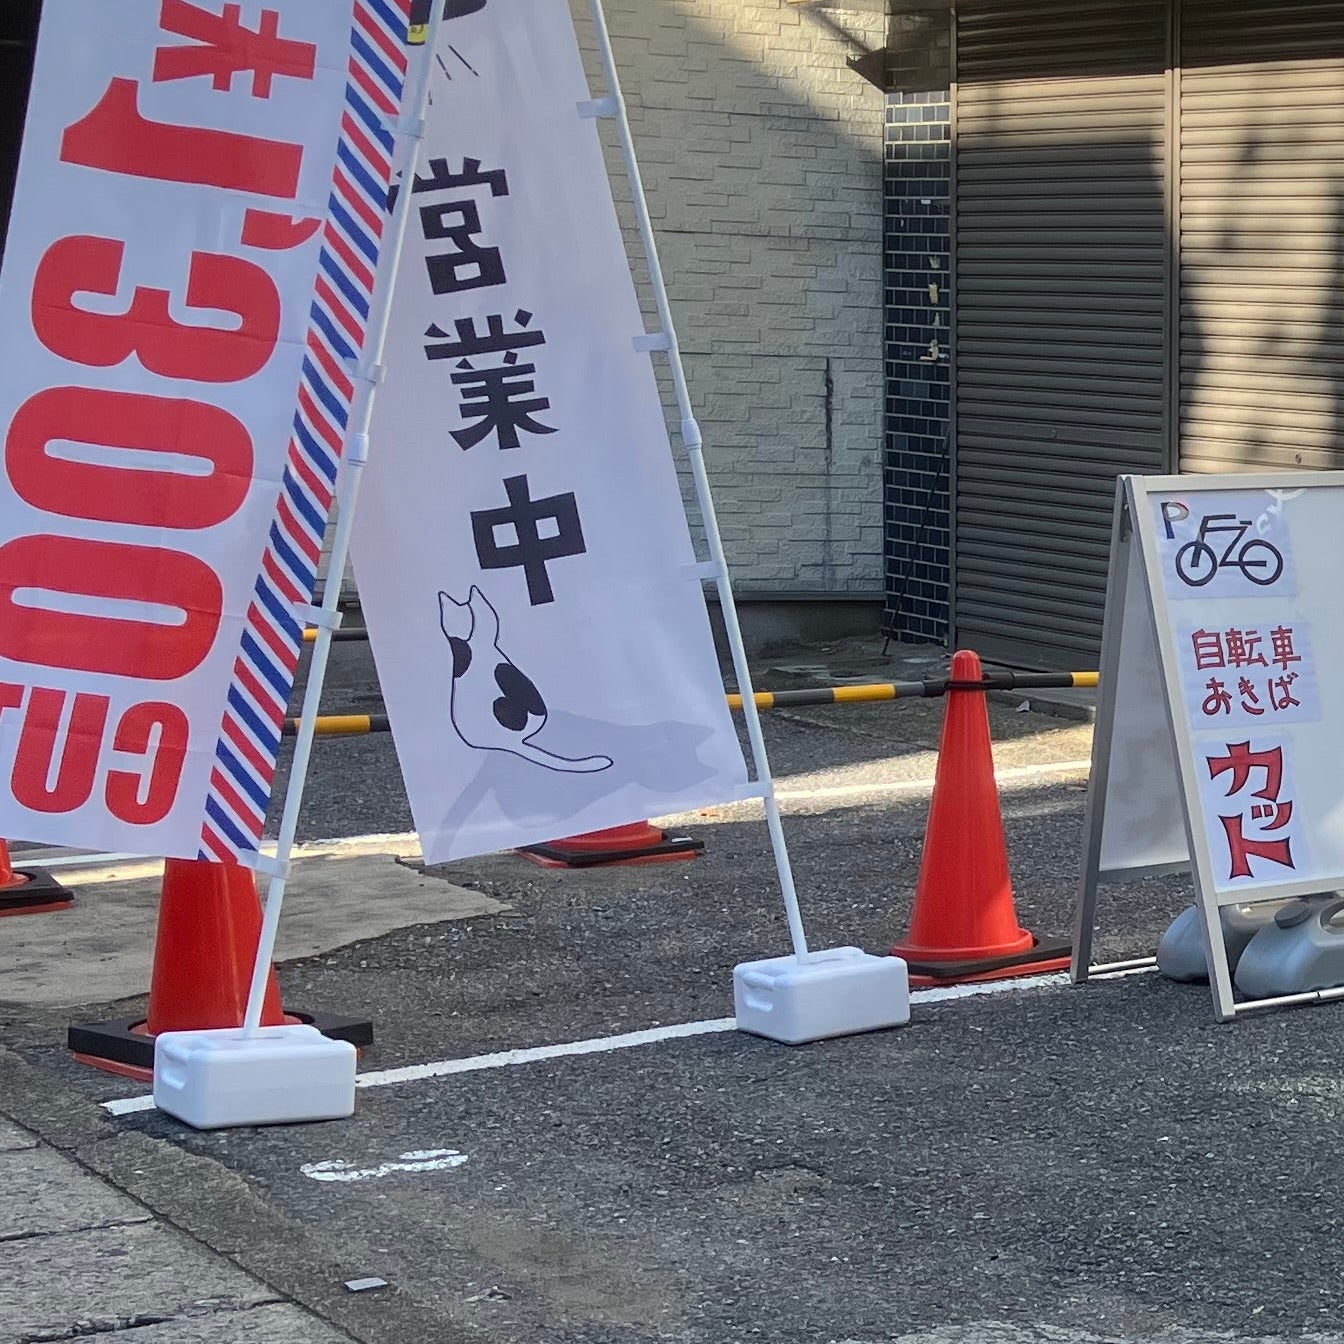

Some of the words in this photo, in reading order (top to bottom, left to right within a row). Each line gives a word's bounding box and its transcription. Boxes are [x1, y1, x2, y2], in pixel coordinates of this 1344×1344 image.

[387, 157, 586, 606] 営業中
[1161, 501, 1189, 539] P
[1192, 625, 1302, 671] 自転車
[1202, 672, 1301, 716] おきば
[1206, 740, 1296, 880] カット
